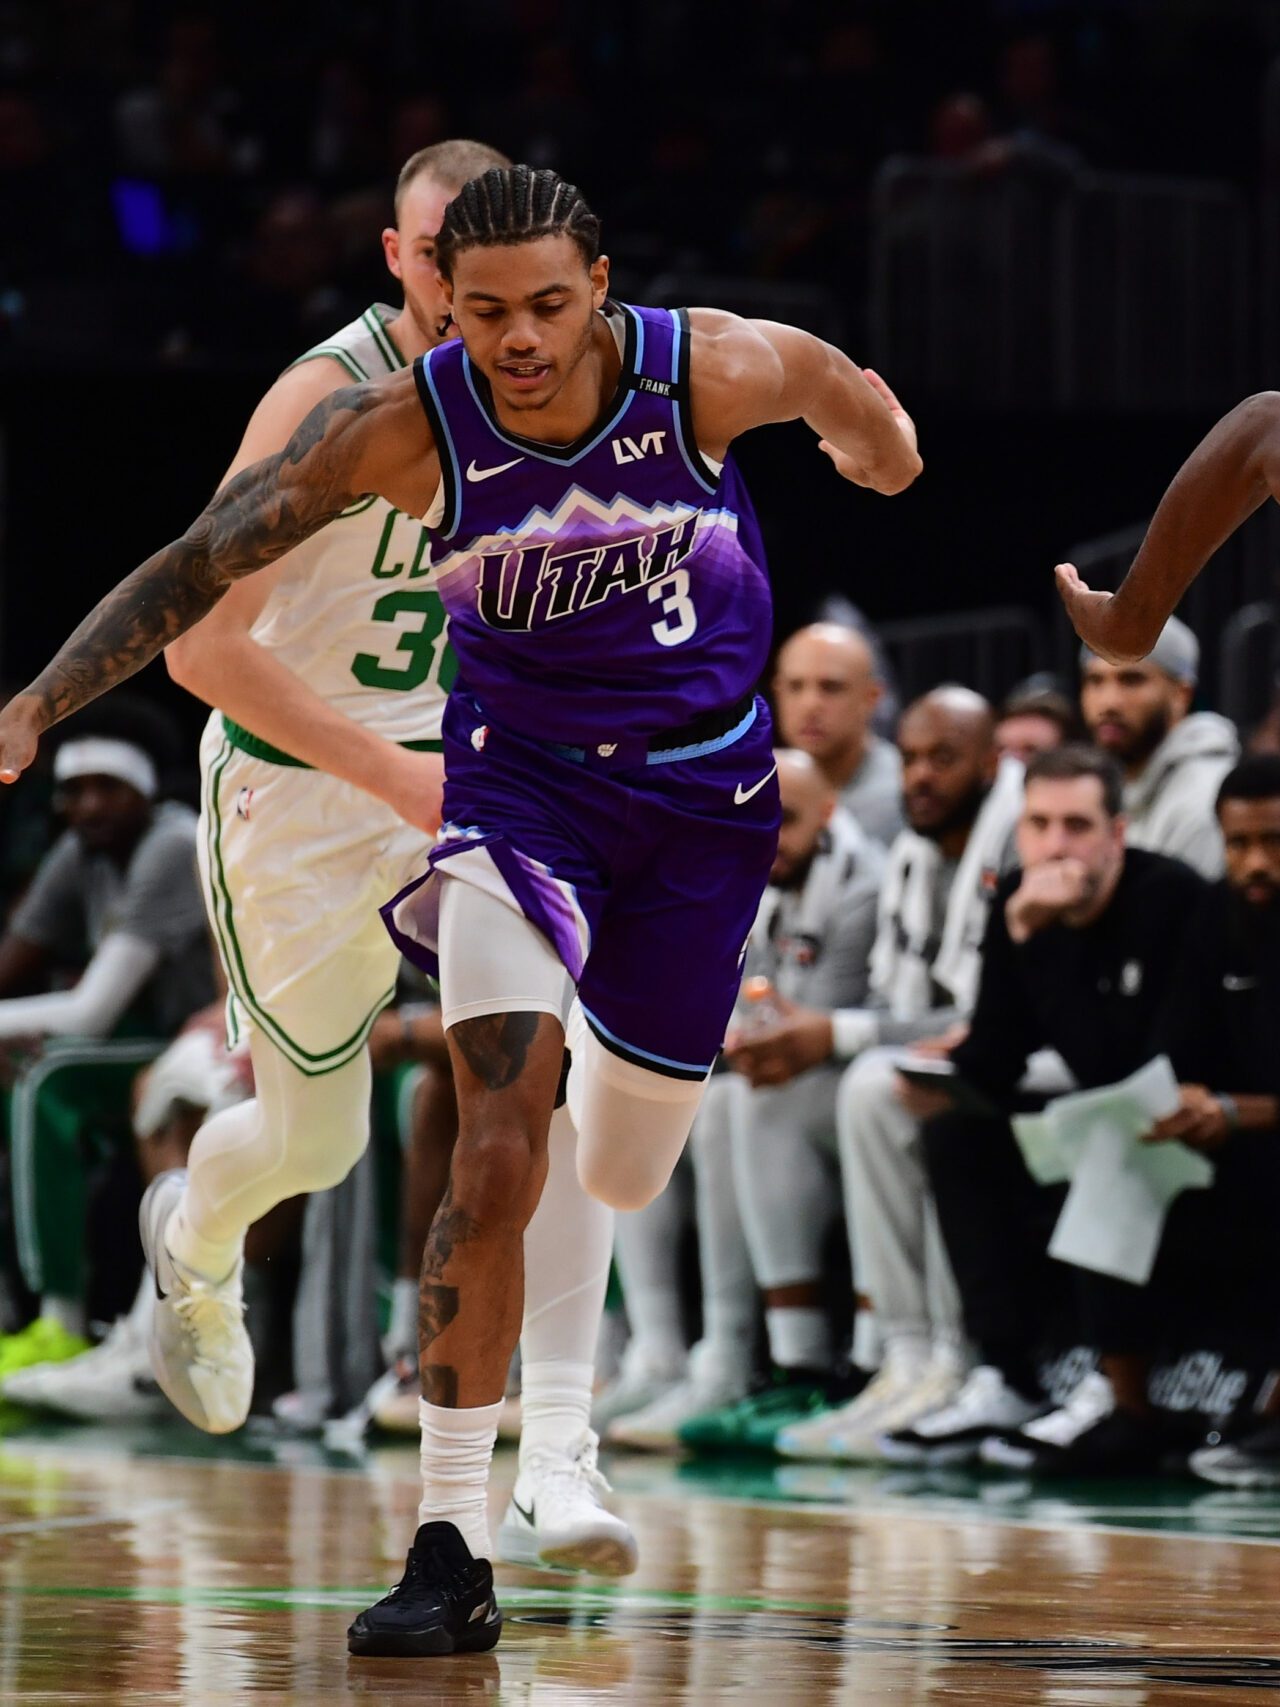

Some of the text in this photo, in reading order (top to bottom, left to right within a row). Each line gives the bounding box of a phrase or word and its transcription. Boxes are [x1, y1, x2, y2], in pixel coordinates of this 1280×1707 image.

[640, 378, 671, 396] FRANK
[612, 431, 666, 465] LVT
[476, 507, 702, 632] UTAH
[648, 569, 698, 647] 3
[351, 591, 460, 694] 3
